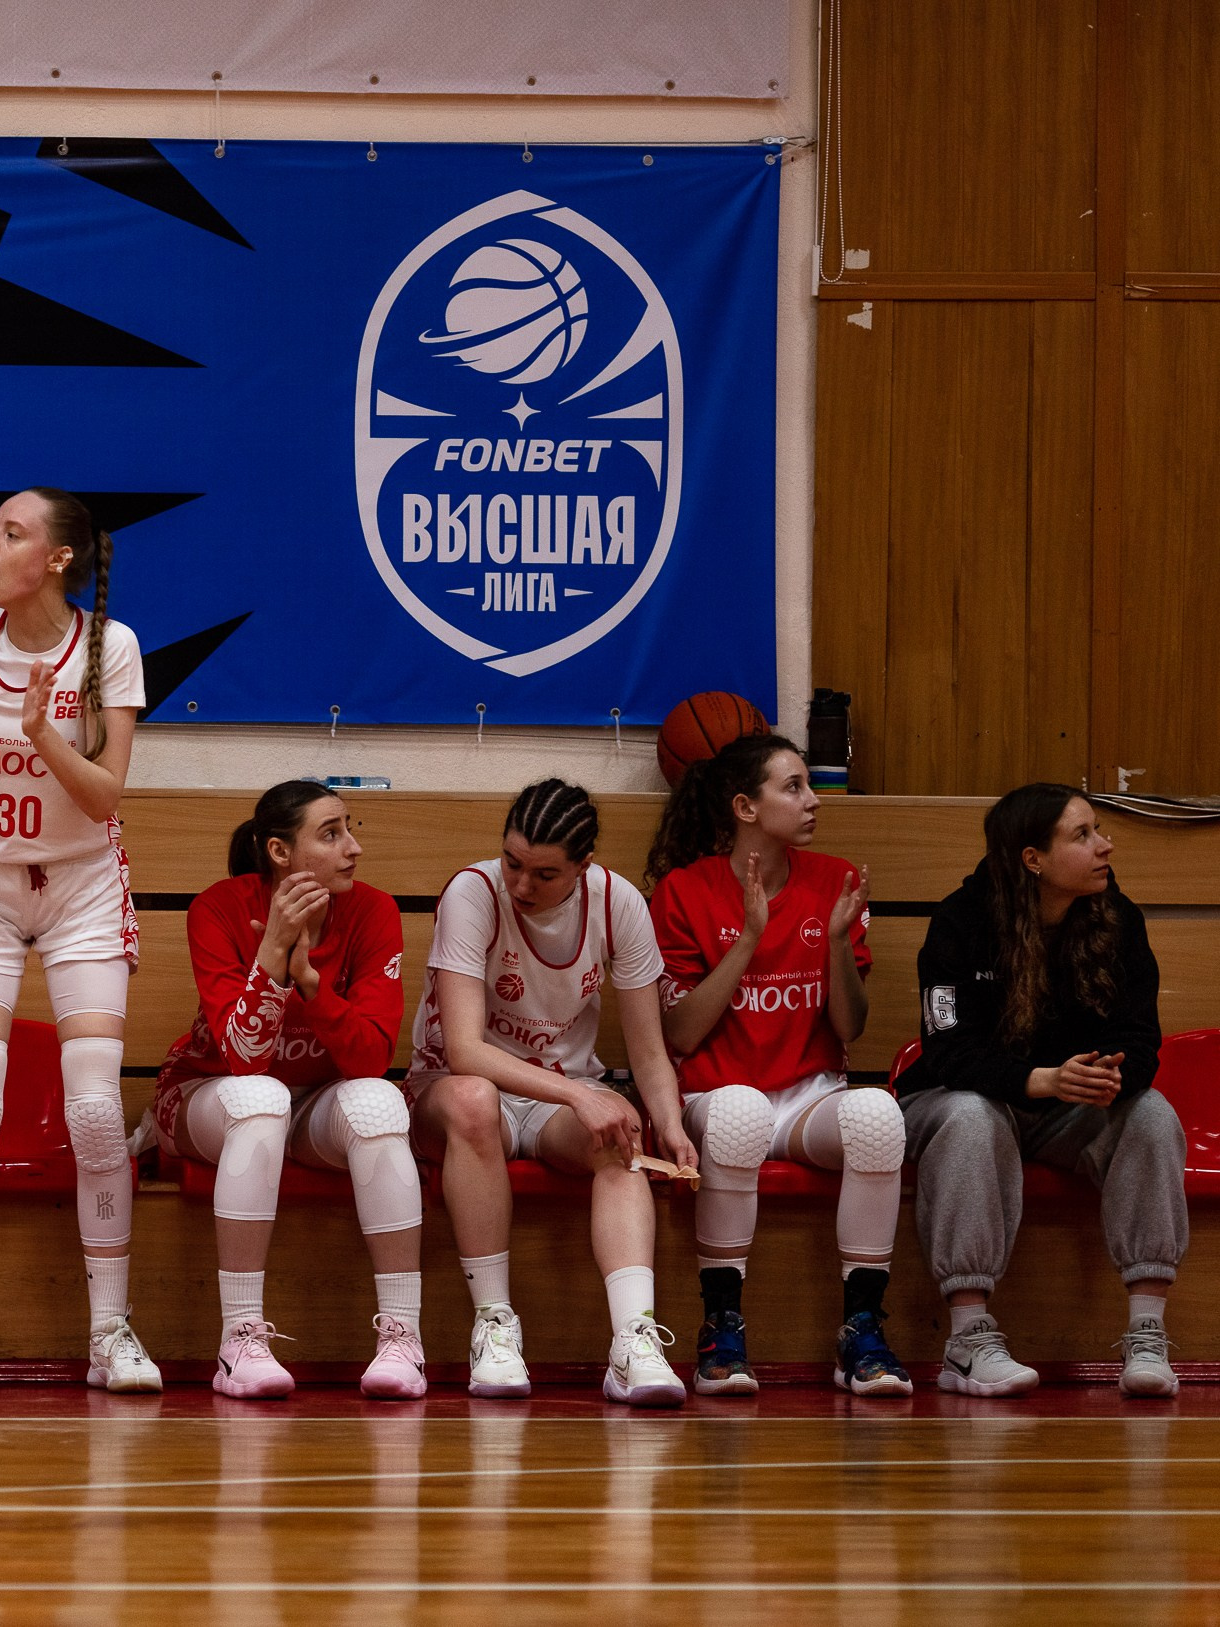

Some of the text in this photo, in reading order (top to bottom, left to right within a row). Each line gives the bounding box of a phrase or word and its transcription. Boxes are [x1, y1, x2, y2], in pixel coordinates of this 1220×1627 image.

[434, 438, 612, 473] FONBET
[402, 493, 636, 565] ВЫСШАЯ
[482, 572, 557, 612] ЛИГА
